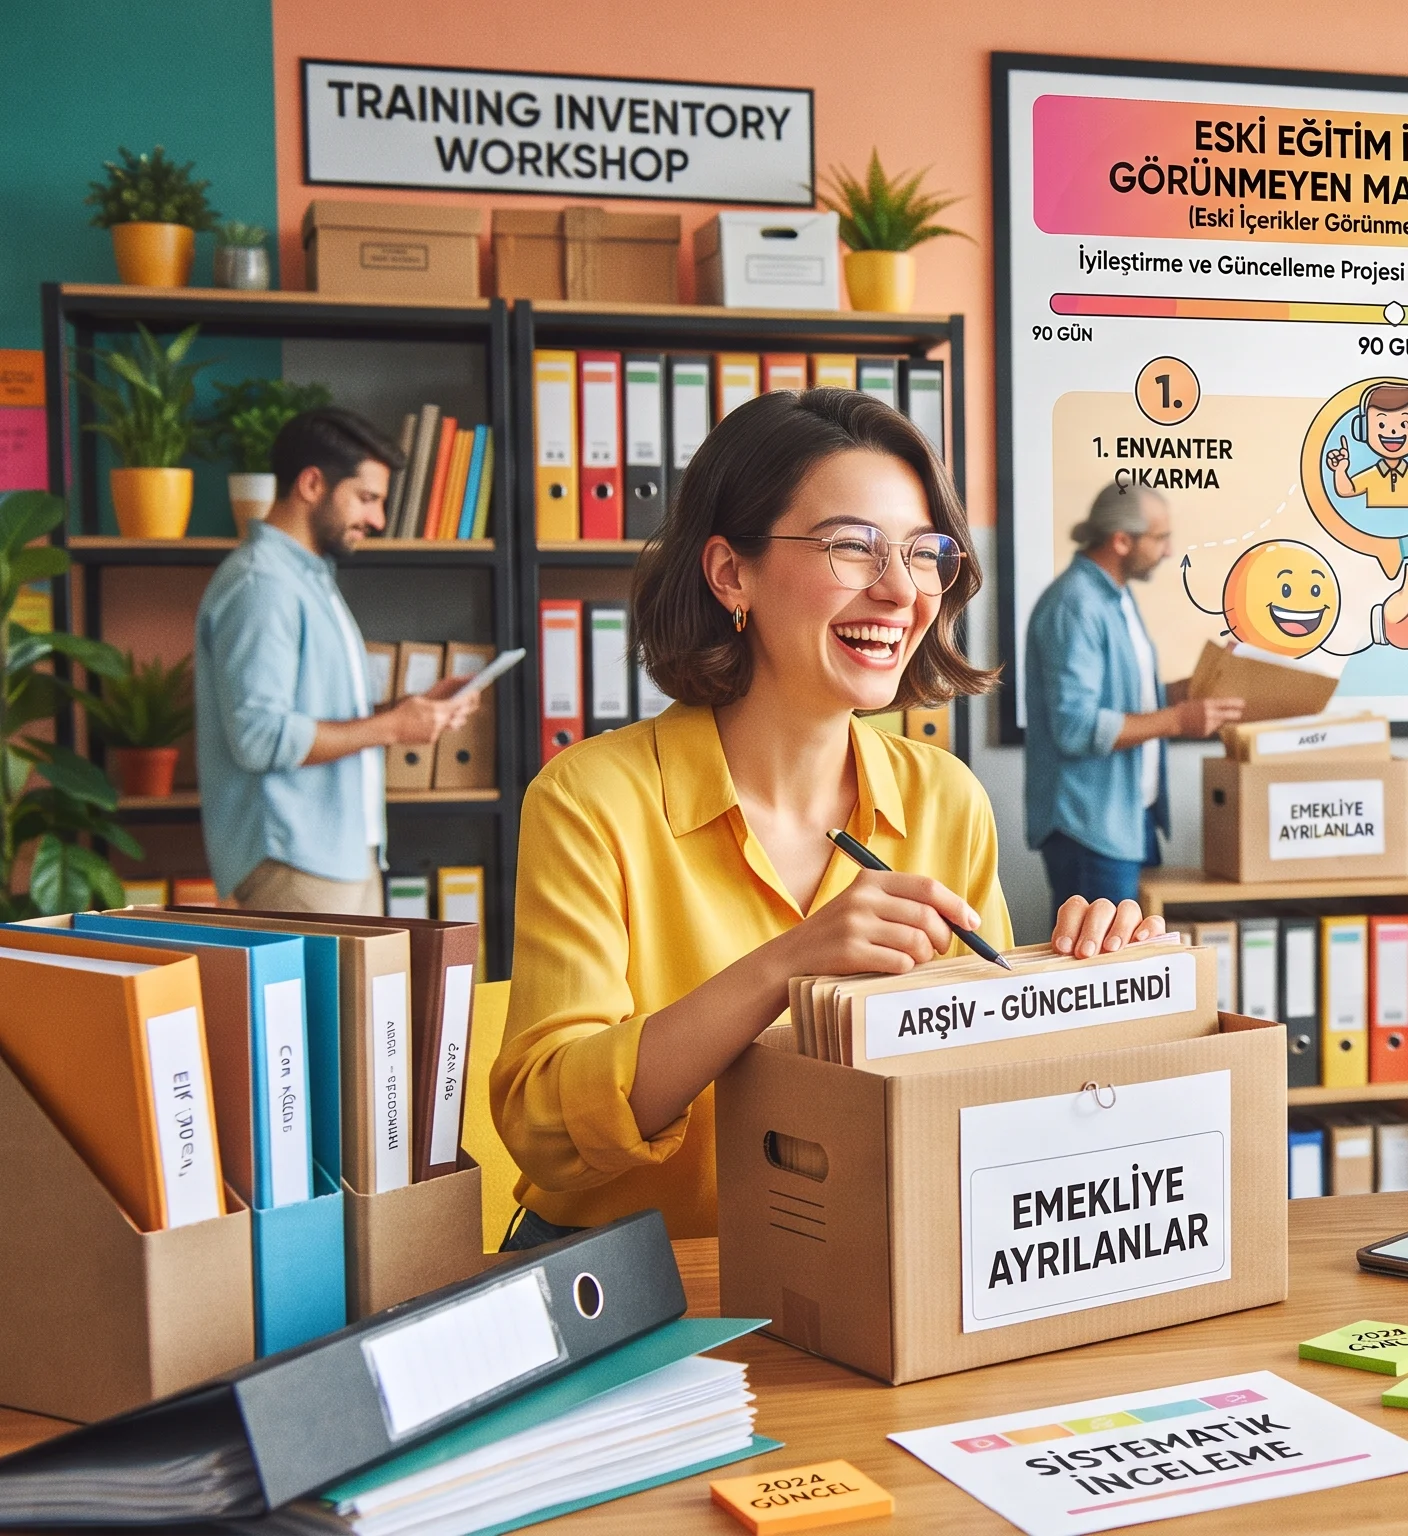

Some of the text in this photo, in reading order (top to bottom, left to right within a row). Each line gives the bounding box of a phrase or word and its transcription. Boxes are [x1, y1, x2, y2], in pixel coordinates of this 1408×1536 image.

[328, 81, 791, 141] TRAINING INVENTORY
[435, 136, 689, 182] WORKSHOP
[1195, 115, 1266, 154] ESKİ
[1279, 118, 1391, 160] EĞİTİM
[1110, 155, 1352, 203] GÖRÜNMEYEN
[1189, 204, 1234, 230] (Eski
[1240, 204, 1319, 235] İçerikler
[1079, 244, 1183, 276] İyileştirme
[1189, 258, 1212, 274] ve
[1217, 255, 1335, 279] Güncelleme
[1341, 260, 1405, 286] Projesi
[1032, 323, 1093, 343] 90 GÜN
[1358, 337, 1384, 356] 90
[1155, 374, 1183, 409] 1.
[1092, 436, 1233, 460] 1. ENVANTER
[1114, 467, 1220, 495] ÇIKARMA
[1291, 799, 1363, 820] EMEKLİYE
[1279, 822, 1375, 842] AYRILANLAR
[898, 996, 976, 1040] ARŞİV
[1001, 966, 1171, 1024] GÜNCELLENDİ
[1012, 1163, 1185, 1231] EMEKLİYE
[988, 1213, 1209, 1290] AYRILANLAR
[1025, 1414, 1291, 1476] SİSTEMATİK
[1070, 1440, 1303, 1496] İNCELEME
